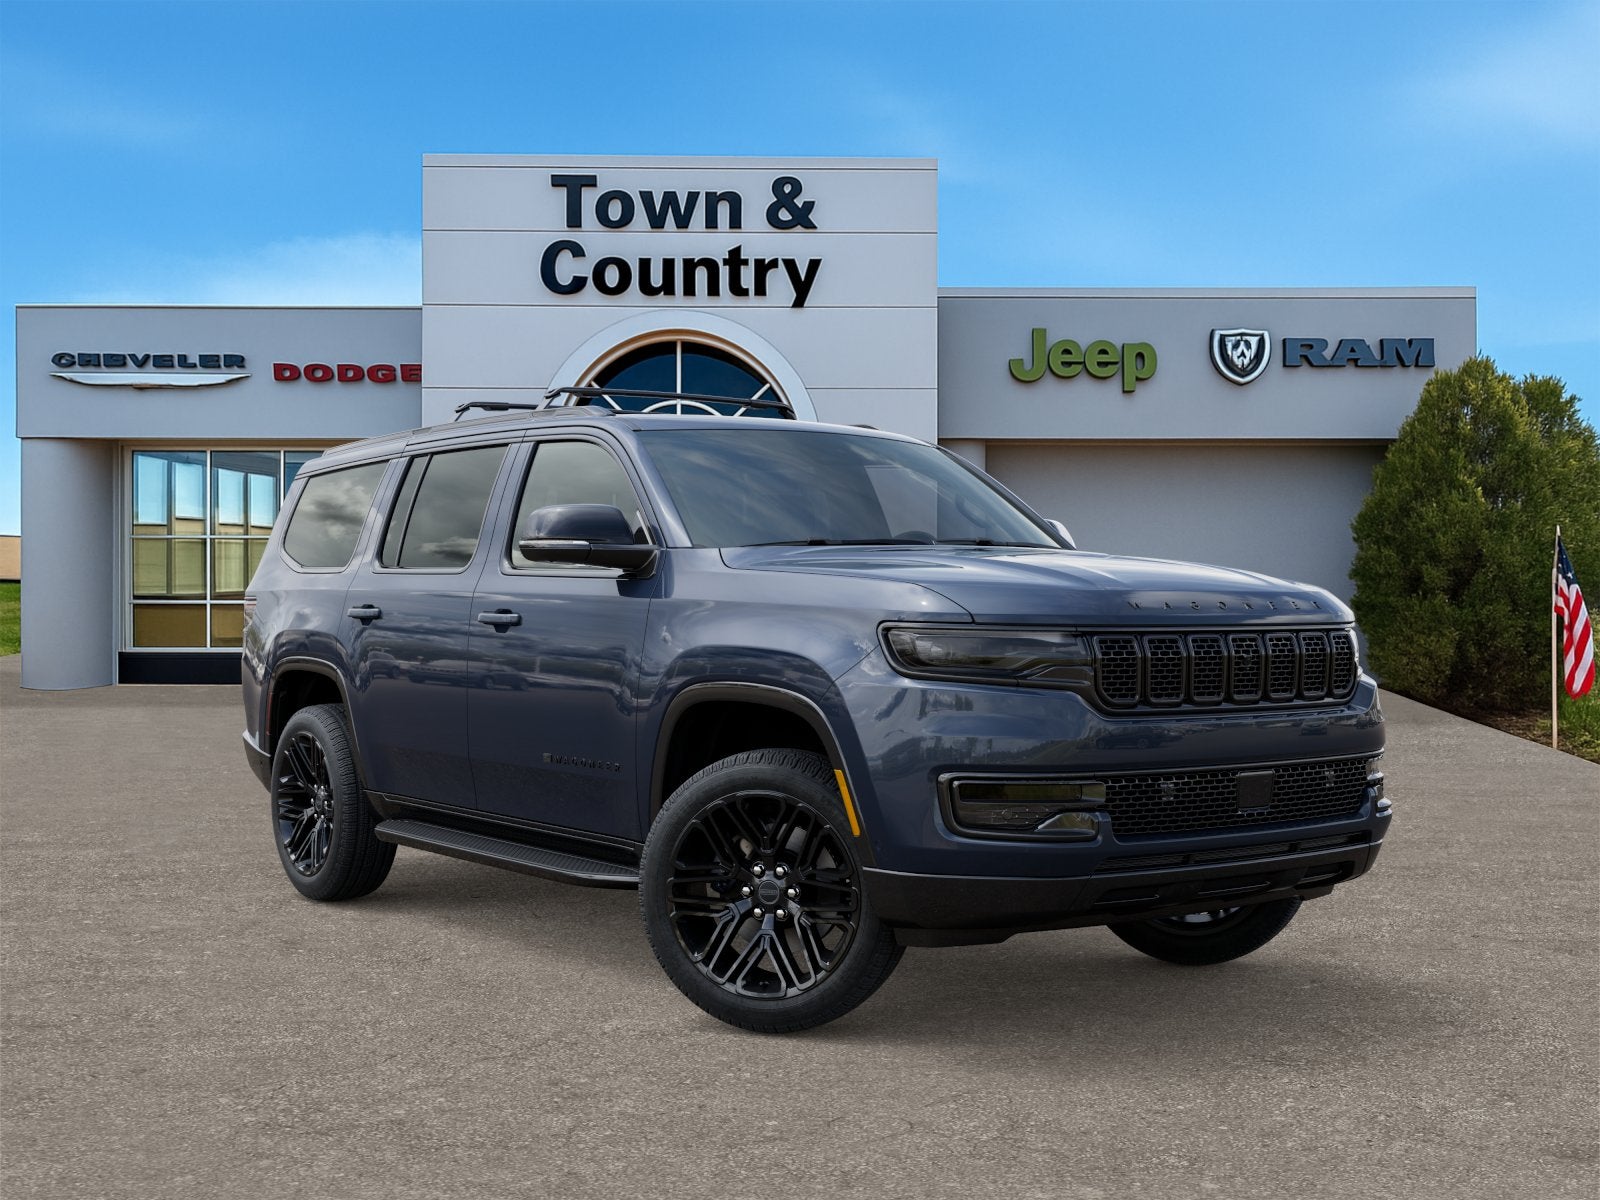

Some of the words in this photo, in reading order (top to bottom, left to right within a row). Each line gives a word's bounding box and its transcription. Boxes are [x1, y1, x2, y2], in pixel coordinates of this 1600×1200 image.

[551, 174, 742, 229] Town
[766, 176, 818, 230] &
[540, 239, 822, 308] Country
[273, 363, 422, 383] DODGE
[1009, 328, 1157, 392] Jeep
[1282, 337, 1436, 368] RAM
